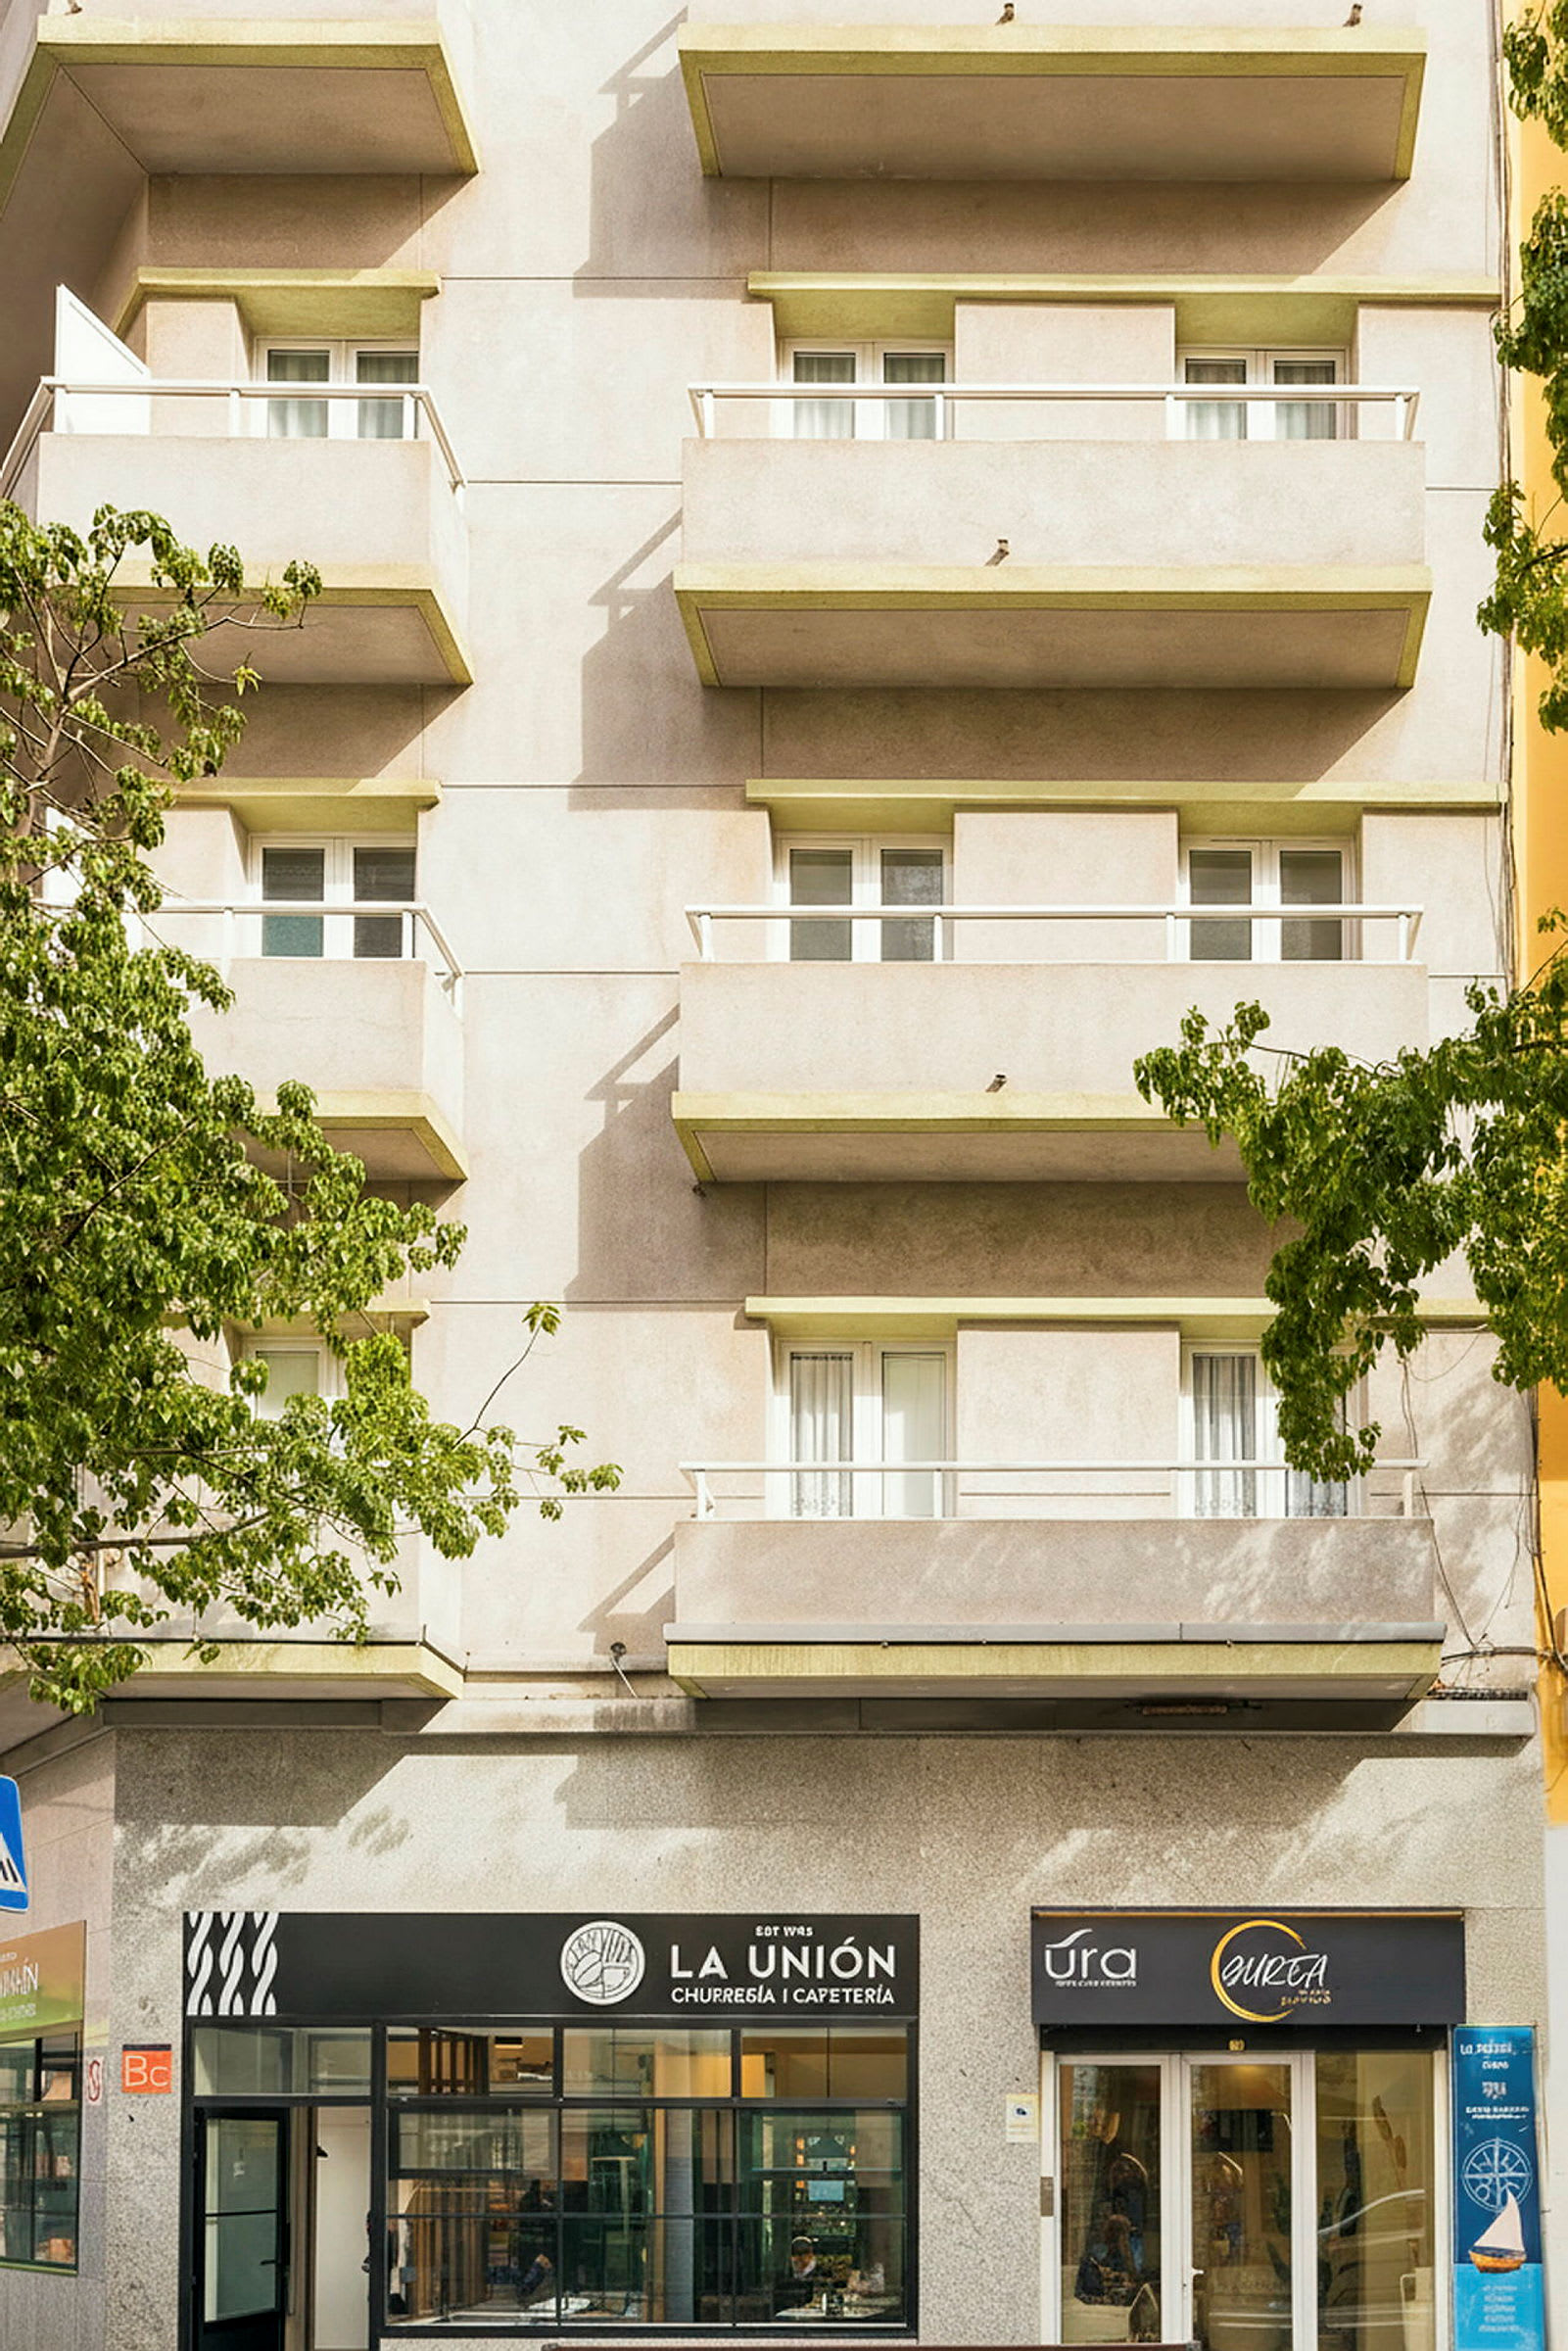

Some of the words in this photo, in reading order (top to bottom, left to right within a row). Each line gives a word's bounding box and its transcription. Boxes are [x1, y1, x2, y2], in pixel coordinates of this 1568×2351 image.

[671, 1944, 728, 1979] LA
[748, 1936, 895, 1979] UNIÓN
[124, 2055, 169, 2087] Bc
